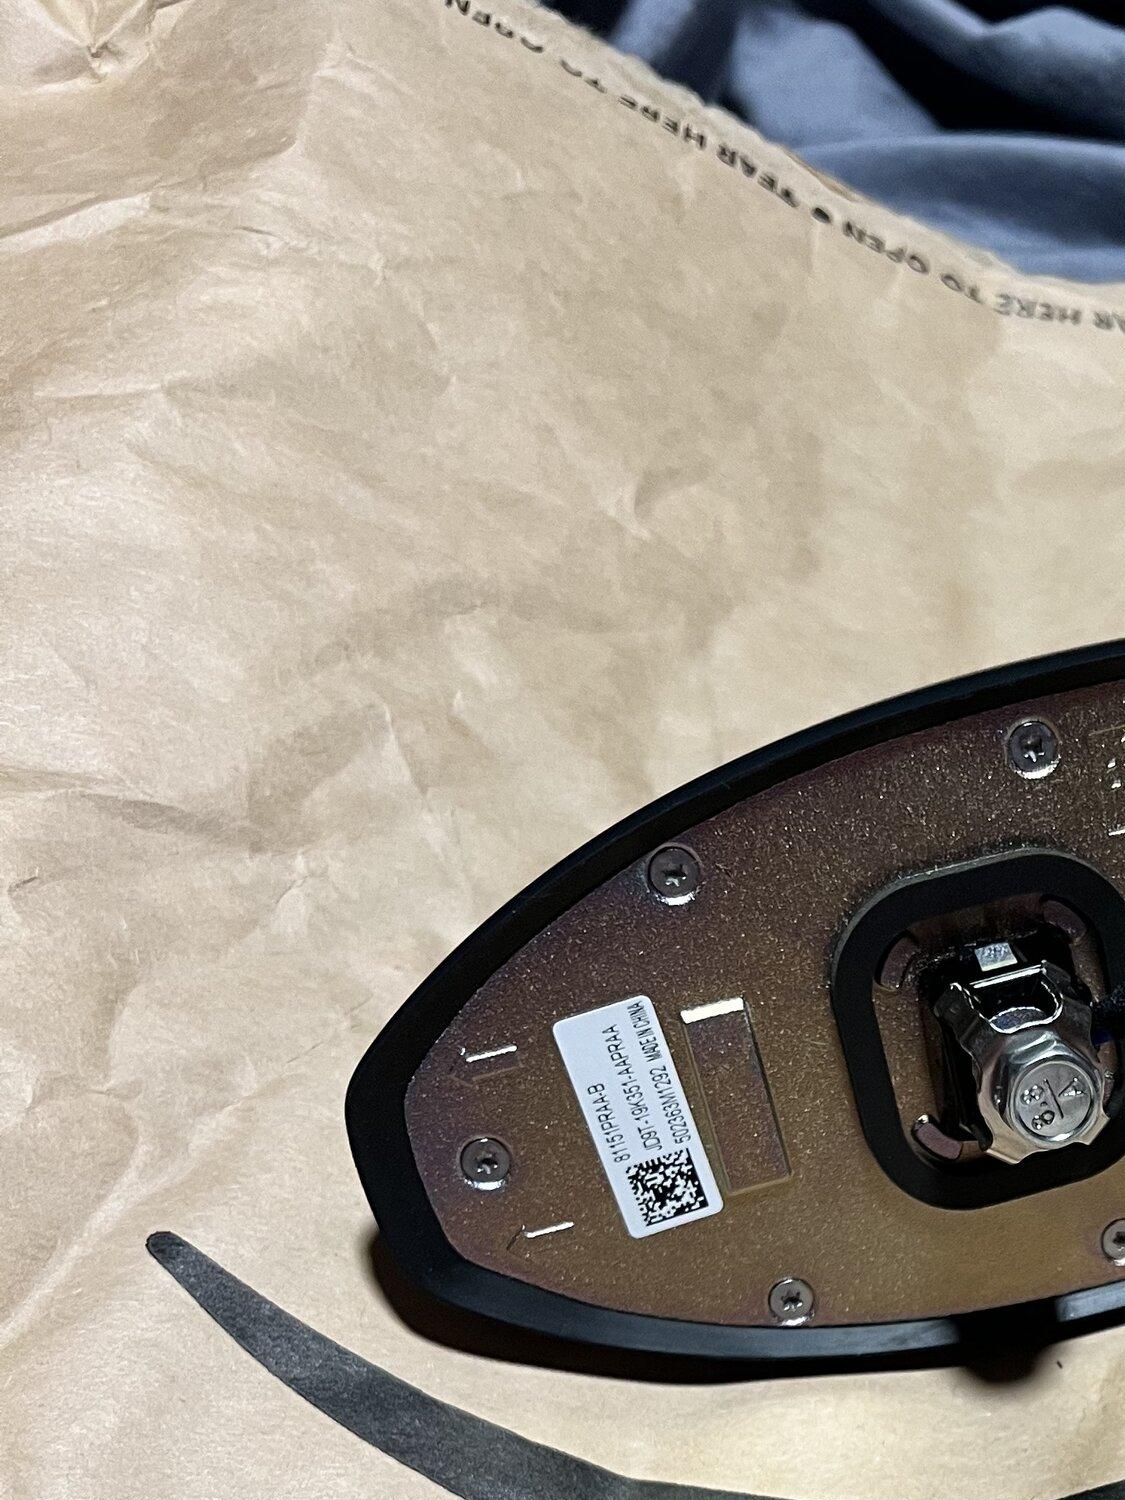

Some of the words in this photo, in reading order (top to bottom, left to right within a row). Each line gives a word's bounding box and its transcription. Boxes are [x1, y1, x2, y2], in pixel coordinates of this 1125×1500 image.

[618, 93, 707, 150] HERE
[716, 142, 800, 208] TEAR
[842, 220, 930, 275] OPEN
[940, 273, 984, 304] TO
[995, 293, 1082, 326] HERE
[627, 1001, 650, 1029] CHINA
[640, 1037, 662, 1062] MADE
[602, 1024, 663, 1151] JD9T-19K351-AAPRAA
[650, 1065, 691, 1144] 502363M1292
[587, 1083, 630, 1163] 81151PRAA-B
